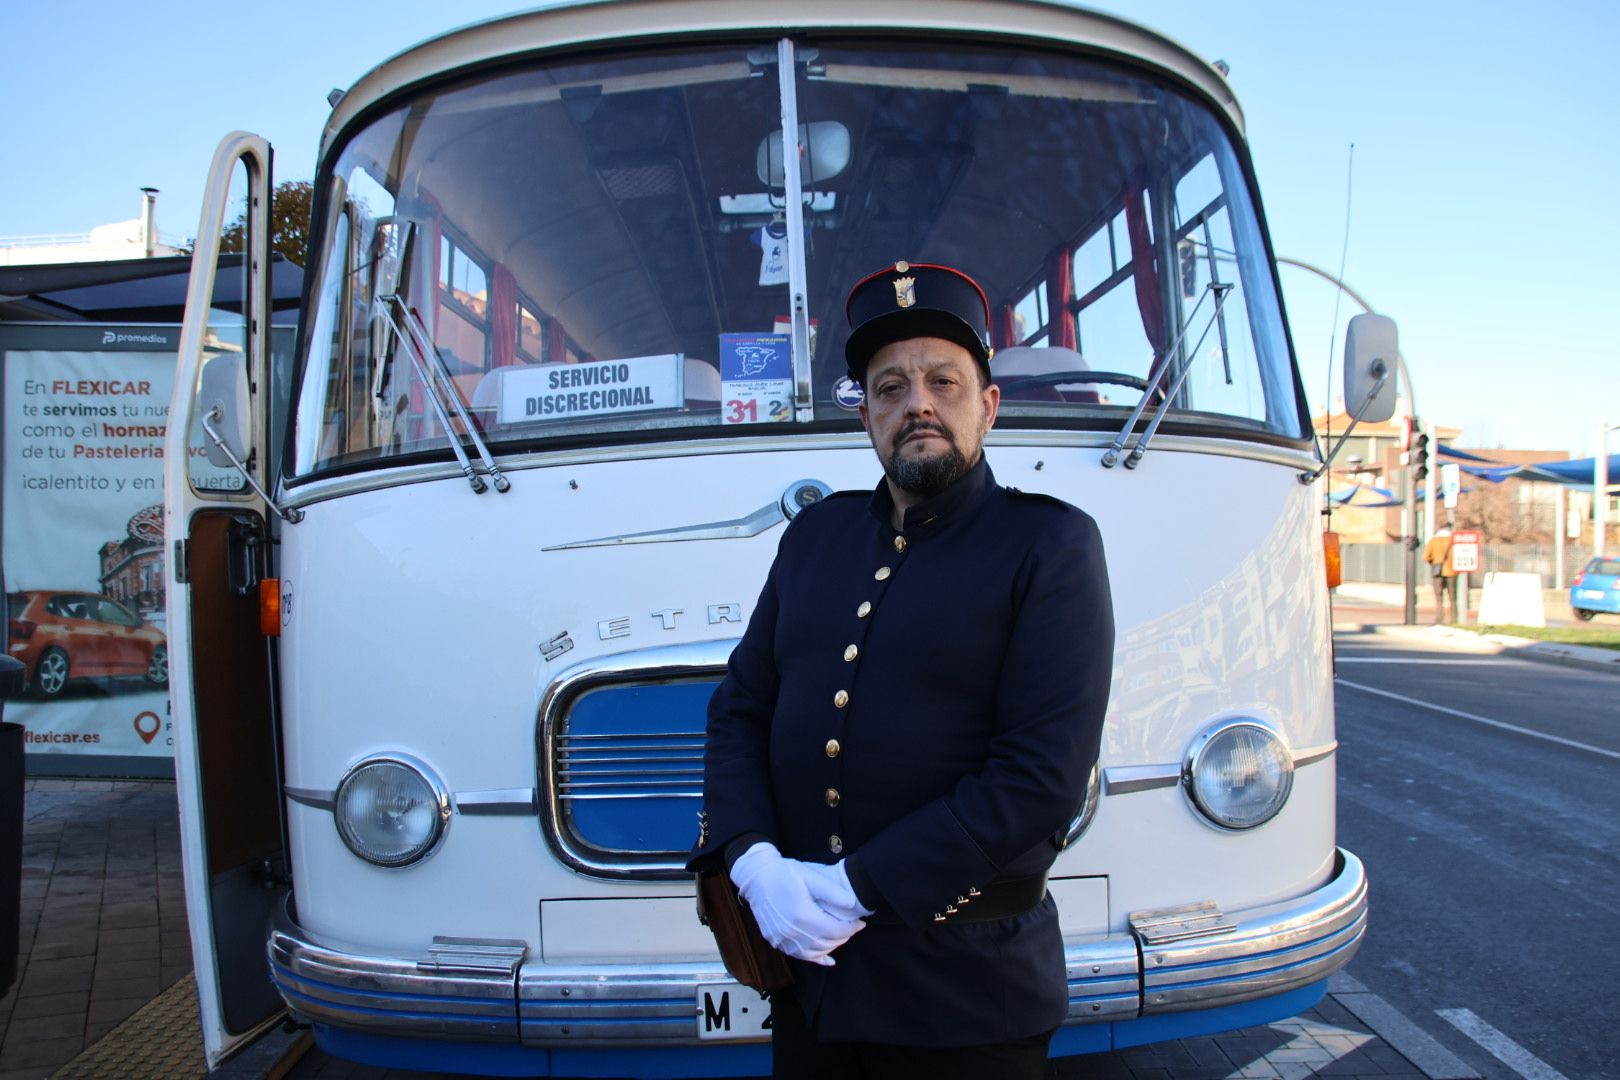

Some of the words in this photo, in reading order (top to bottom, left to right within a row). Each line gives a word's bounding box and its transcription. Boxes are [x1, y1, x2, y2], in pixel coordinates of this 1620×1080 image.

[117, 334, 167, 344] promedios
[548, 363, 629, 390] SERVICIO
[24, 380, 46, 395] En
[52, 380, 151, 395] FLEXICAR
[526, 386, 654, 416] DISCRECIONAL
[23, 404, 38, 416] te
[43, 403, 117, 417] servimos
[123, 404, 139, 416] tu
[144, 406, 170, 416] nue
[726, 399, 757, 424] 31
[22, 425, 75, 437] como
[82, 422, 97, 437] el
[103, 422, 167, 437] hornaz
[22, 445, 43, 459] de
[49, 447, 65, 459] tu
[116, 478, 126, 492] y
[133, 478, 155, 489] en
[539, 602, 742, 662] SETR
[24, 731, 100, 744] flexicar.es
